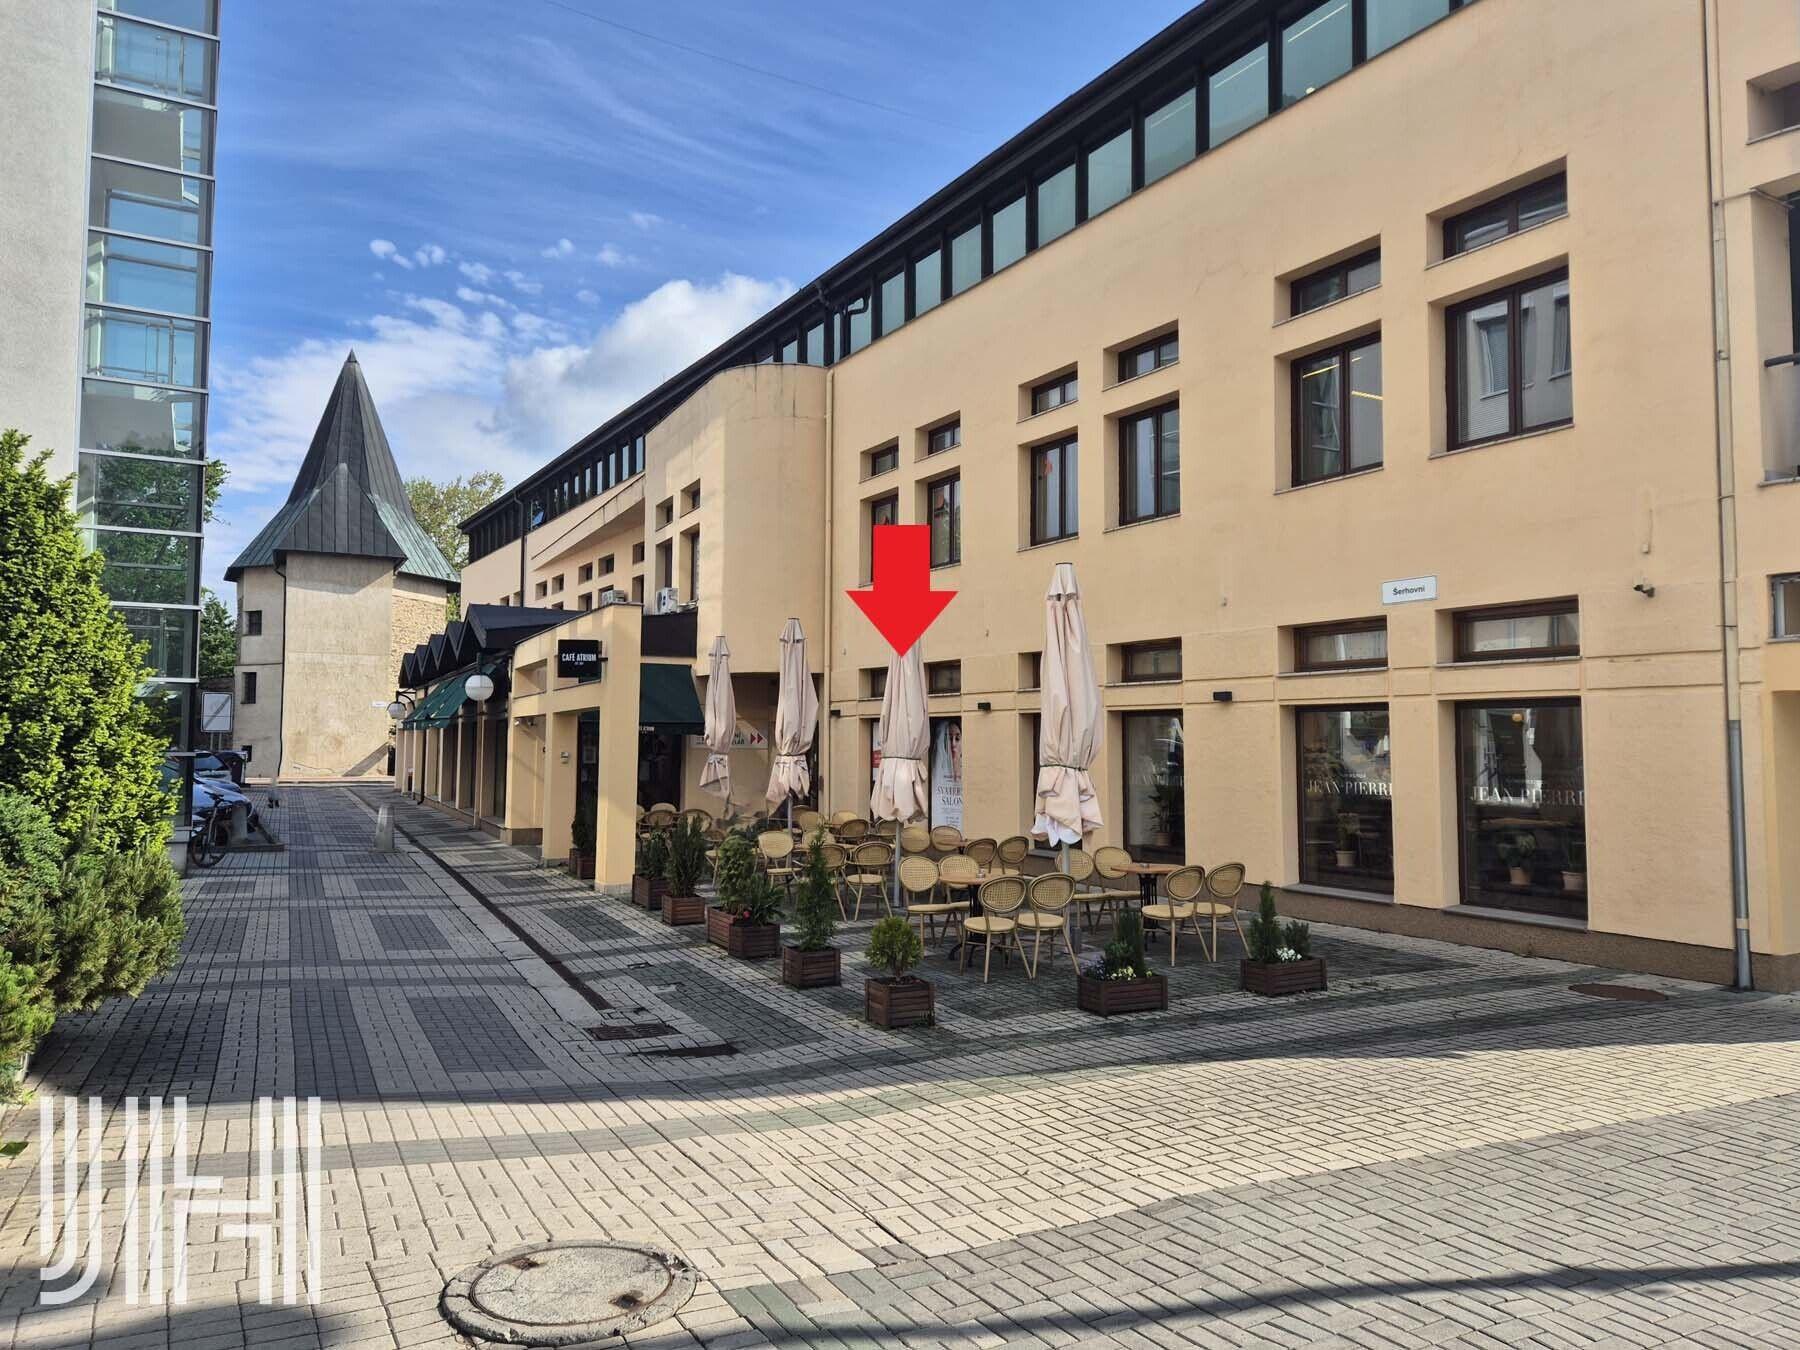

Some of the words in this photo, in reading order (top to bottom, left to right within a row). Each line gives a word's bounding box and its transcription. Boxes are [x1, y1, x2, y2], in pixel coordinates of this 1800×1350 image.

[576, 653, 597, 662] ATRIUM
[1307, 780, 1341, 794] JEAN
[1470, 786, 1514, 802] JEAN
